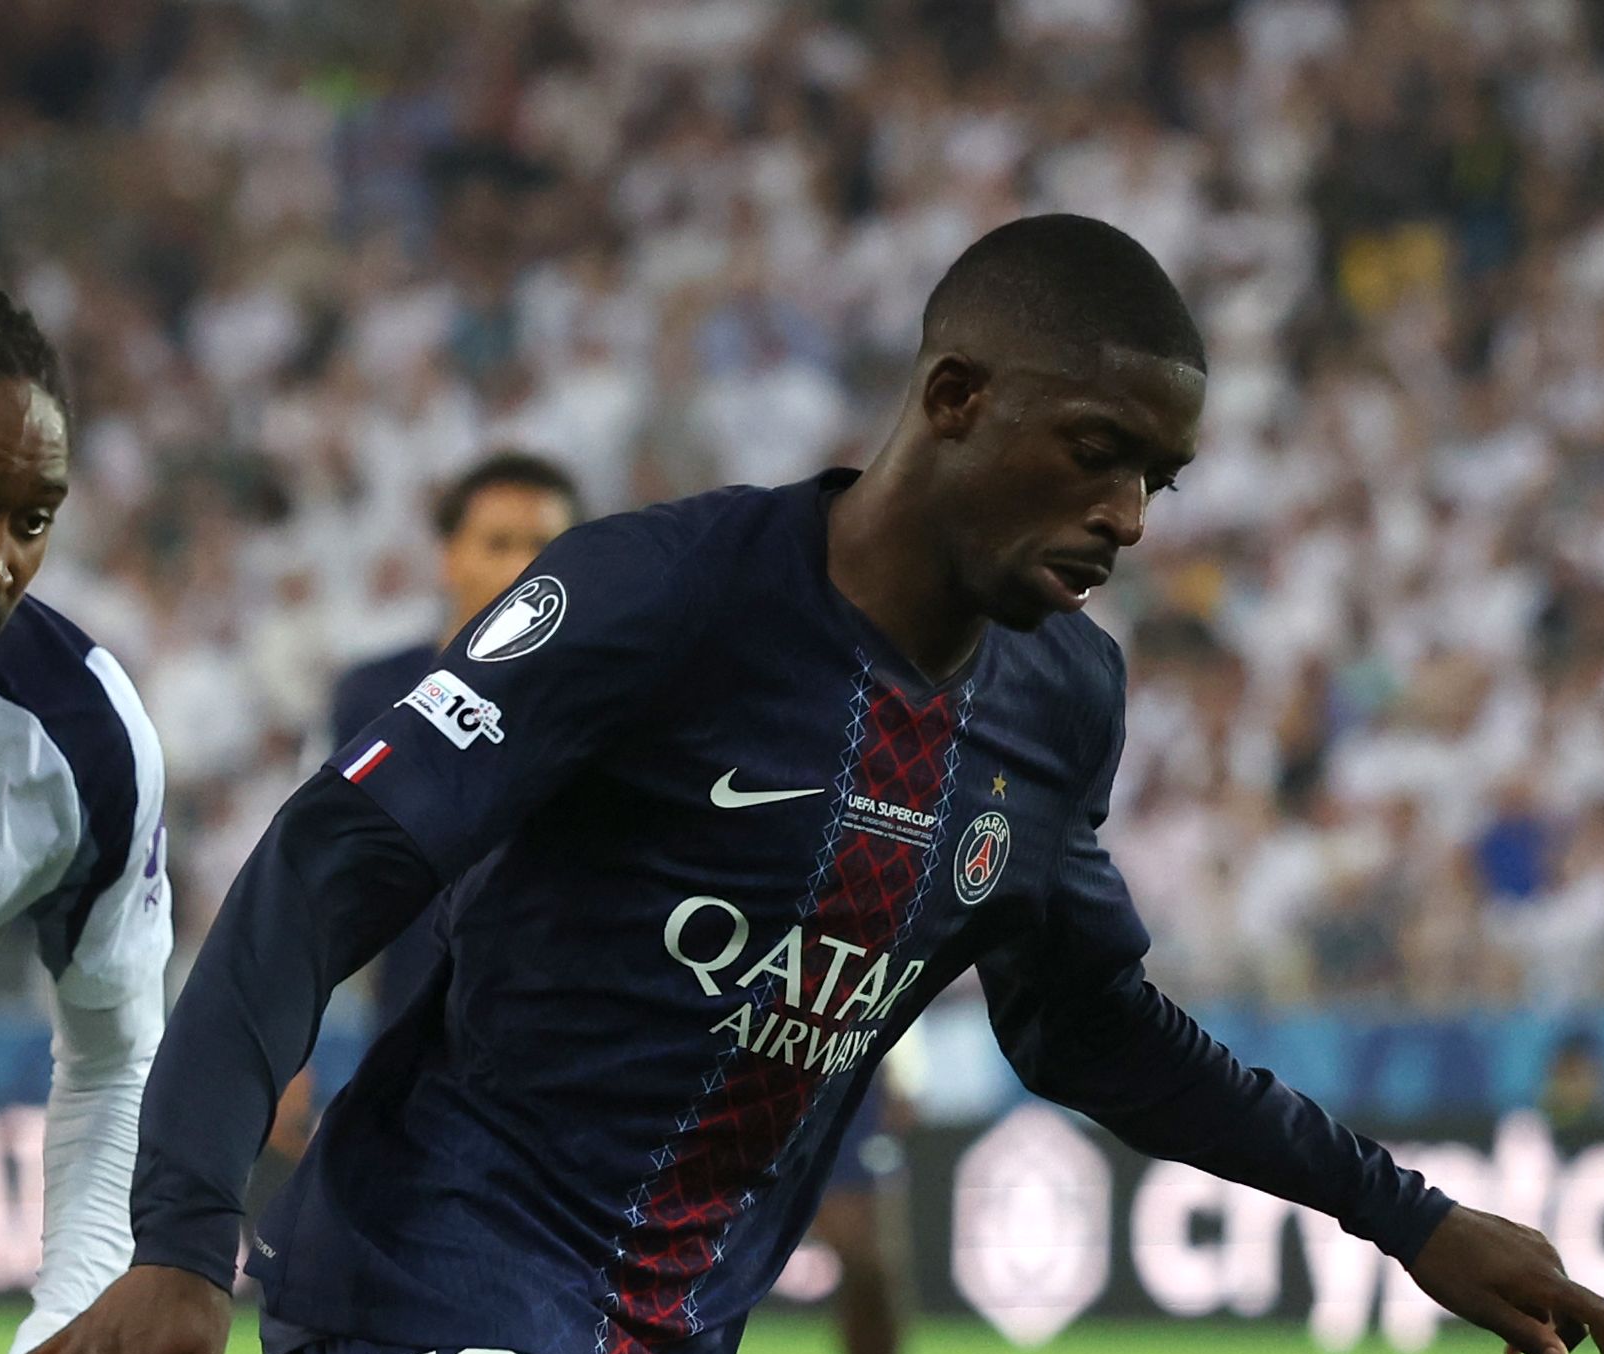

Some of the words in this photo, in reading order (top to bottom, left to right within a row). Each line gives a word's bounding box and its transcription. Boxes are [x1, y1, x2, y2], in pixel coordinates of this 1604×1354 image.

[848, 794, 876, 814] UEFA
[877, 801, 911, 824] SUPER
[912, 811, 935, 828] CUP
[974, 816, 1007, 843] PARIS
[663, 895, 925, 1023] QATAR
